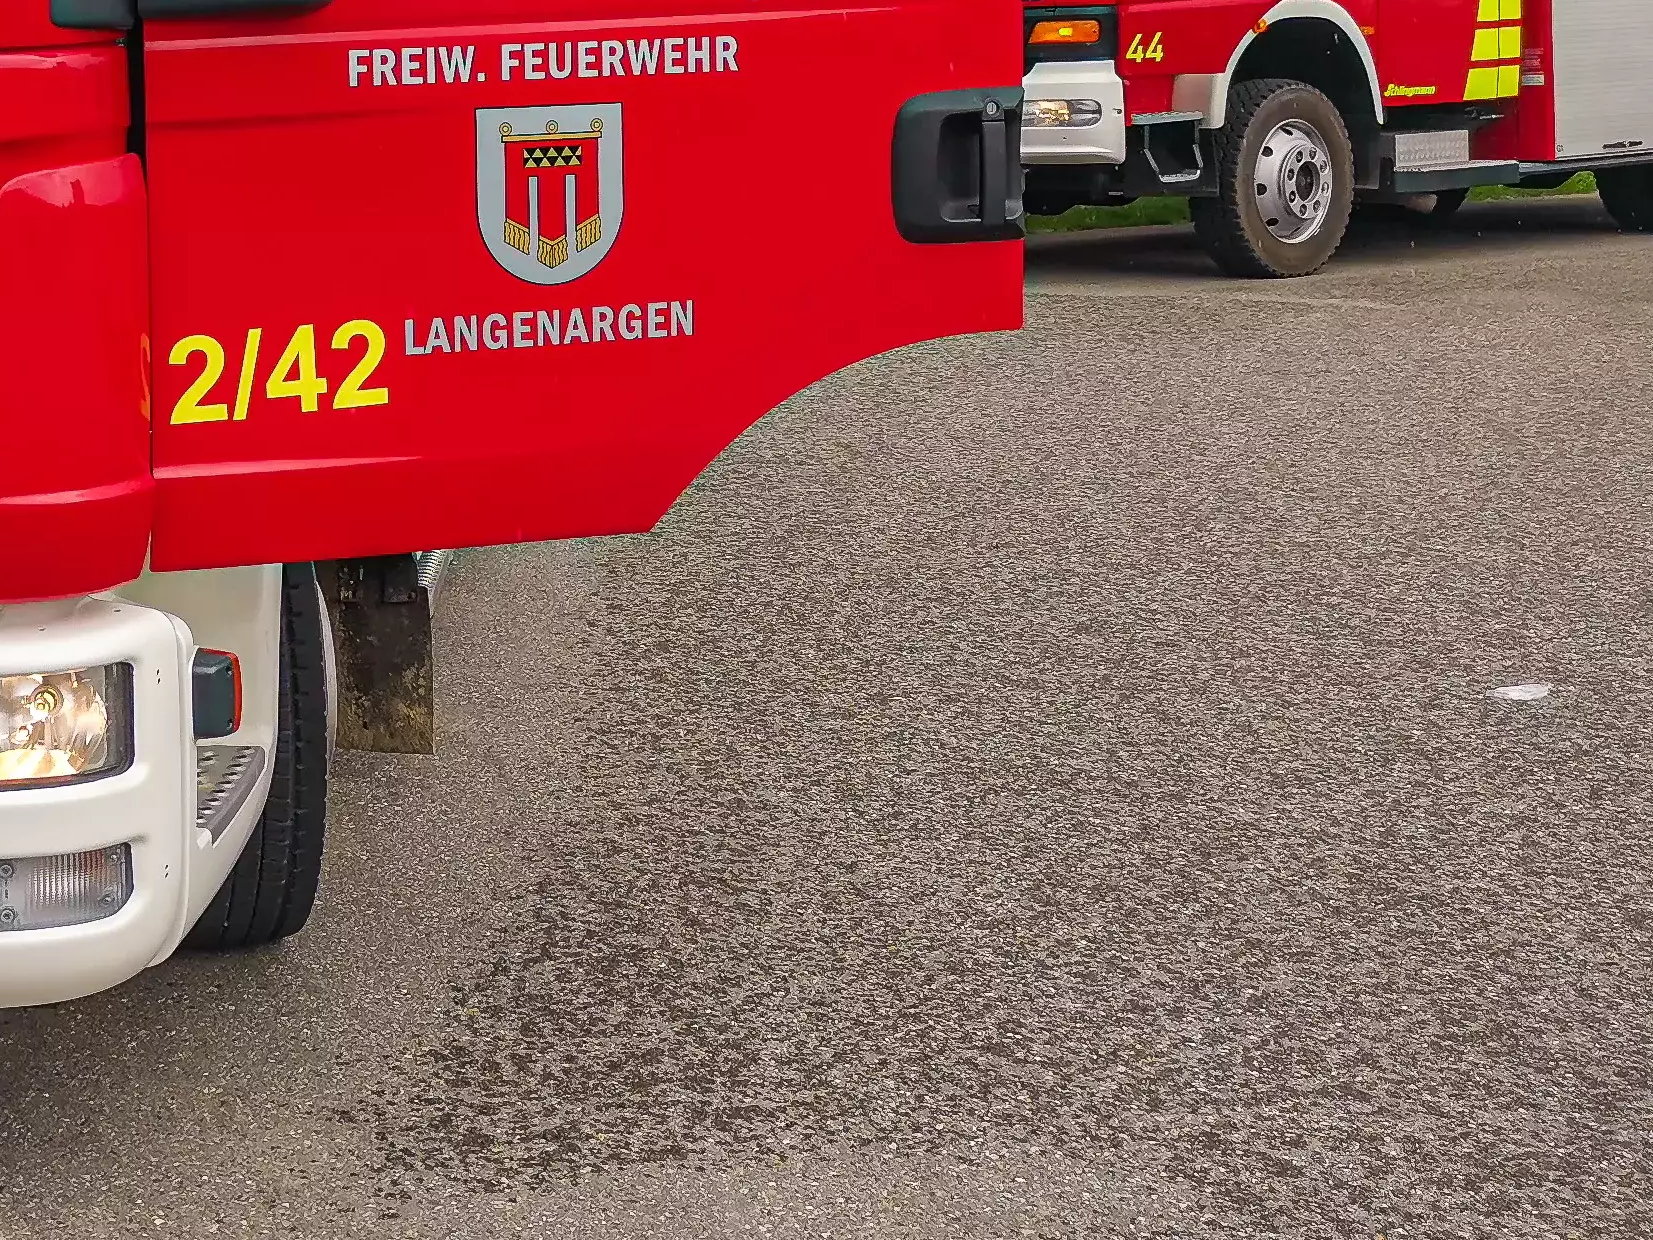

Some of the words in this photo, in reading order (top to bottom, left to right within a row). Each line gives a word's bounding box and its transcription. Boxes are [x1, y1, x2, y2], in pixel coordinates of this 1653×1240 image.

[348, 45, 487, 87] FREIW.
[501, 35, 740, 82] FEUERWEHR
[1125, 31, 1164, 63] 44
[404, 299, 695, 356] LANGENARGEN
[167, 319, 390, 425] 2/42
